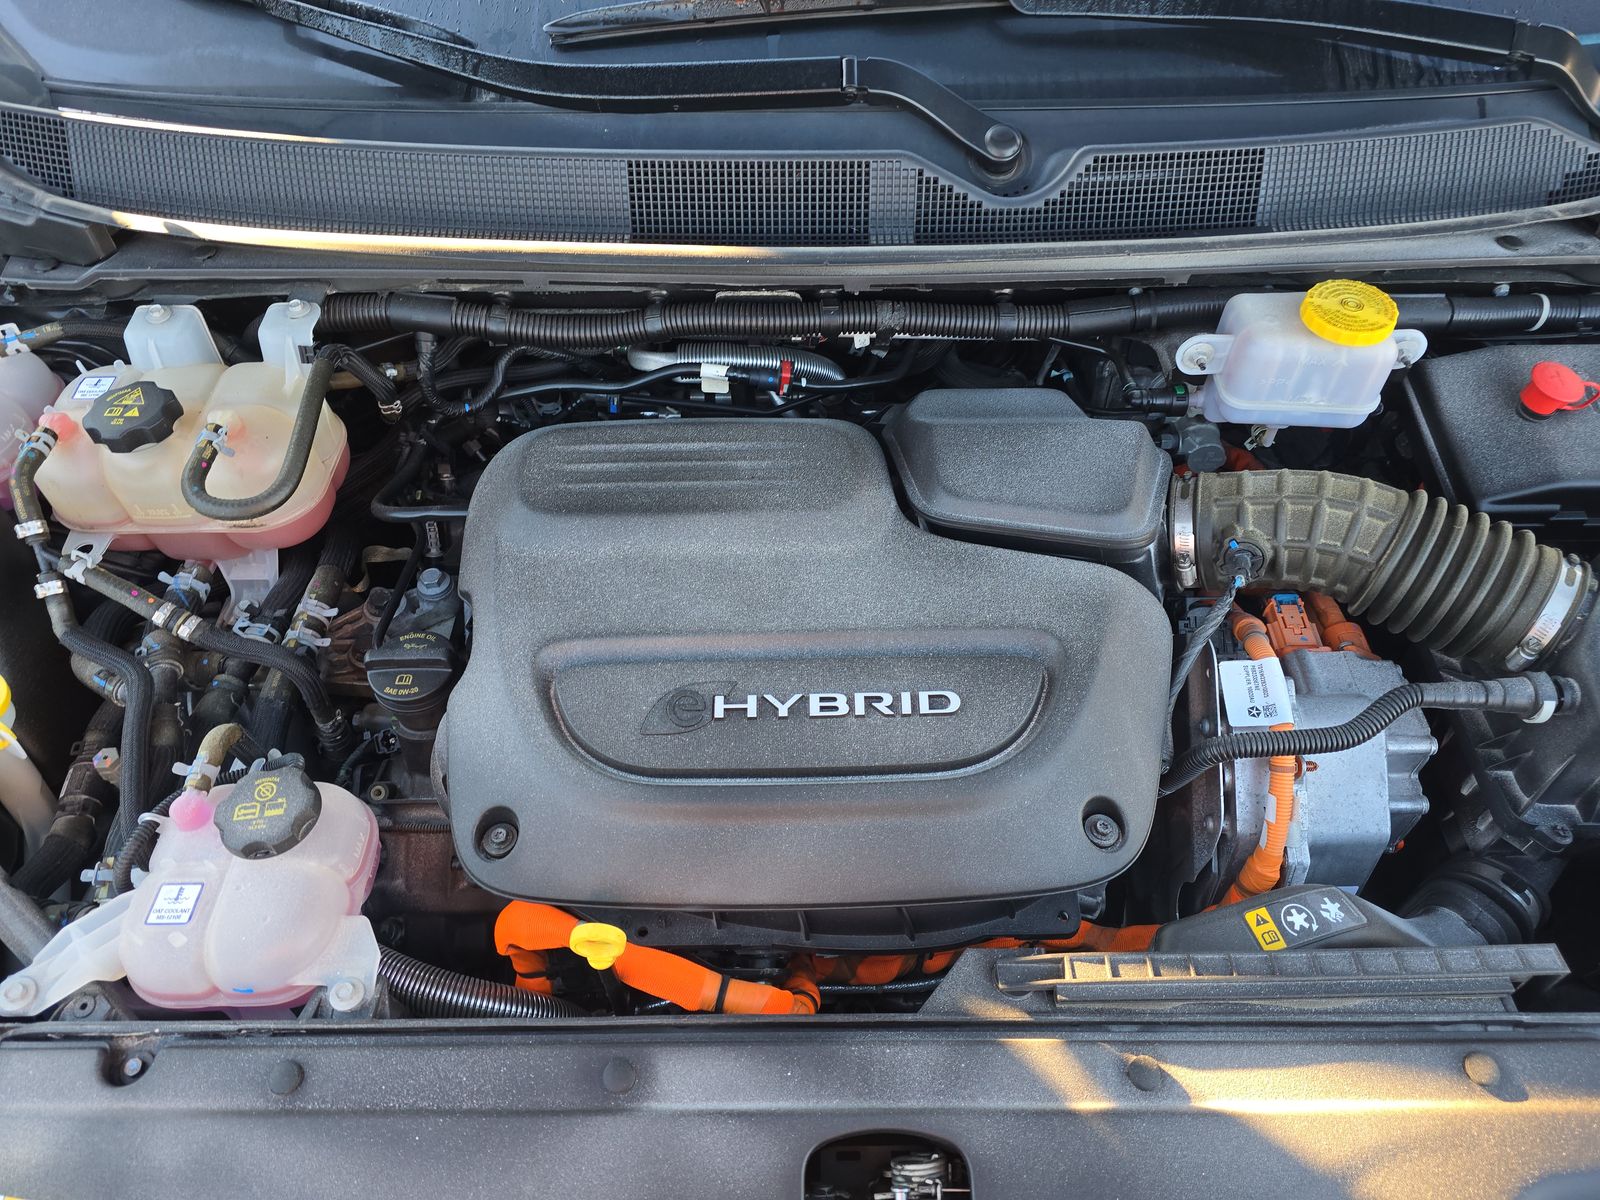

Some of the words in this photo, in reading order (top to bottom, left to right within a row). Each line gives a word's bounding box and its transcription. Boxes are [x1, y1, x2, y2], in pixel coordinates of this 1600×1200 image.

[400, 632, 426, 641] ENGINE
[426, 633, 437, 641] OIL
[1243, 665, 1251, 685] SUPPLIER
[384, 687, 397, 695] SAE
